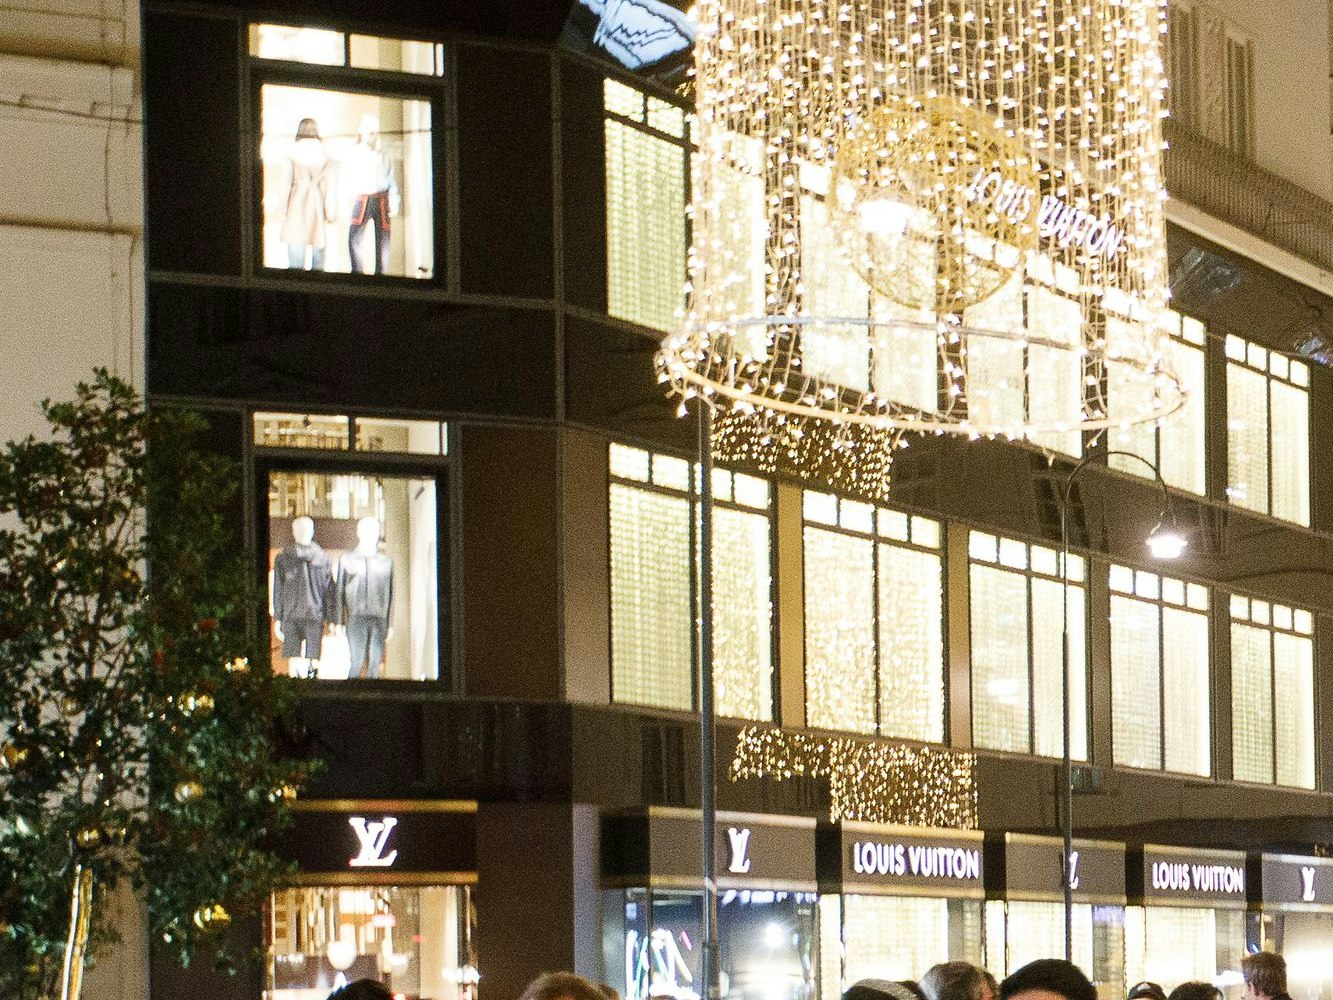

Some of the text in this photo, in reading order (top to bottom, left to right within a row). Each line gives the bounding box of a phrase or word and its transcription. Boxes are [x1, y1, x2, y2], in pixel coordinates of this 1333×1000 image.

[853, 841, 981, 879] LOUIS VUITTON
[1152, 861, 1244, 894] LOUIS VUITTON
